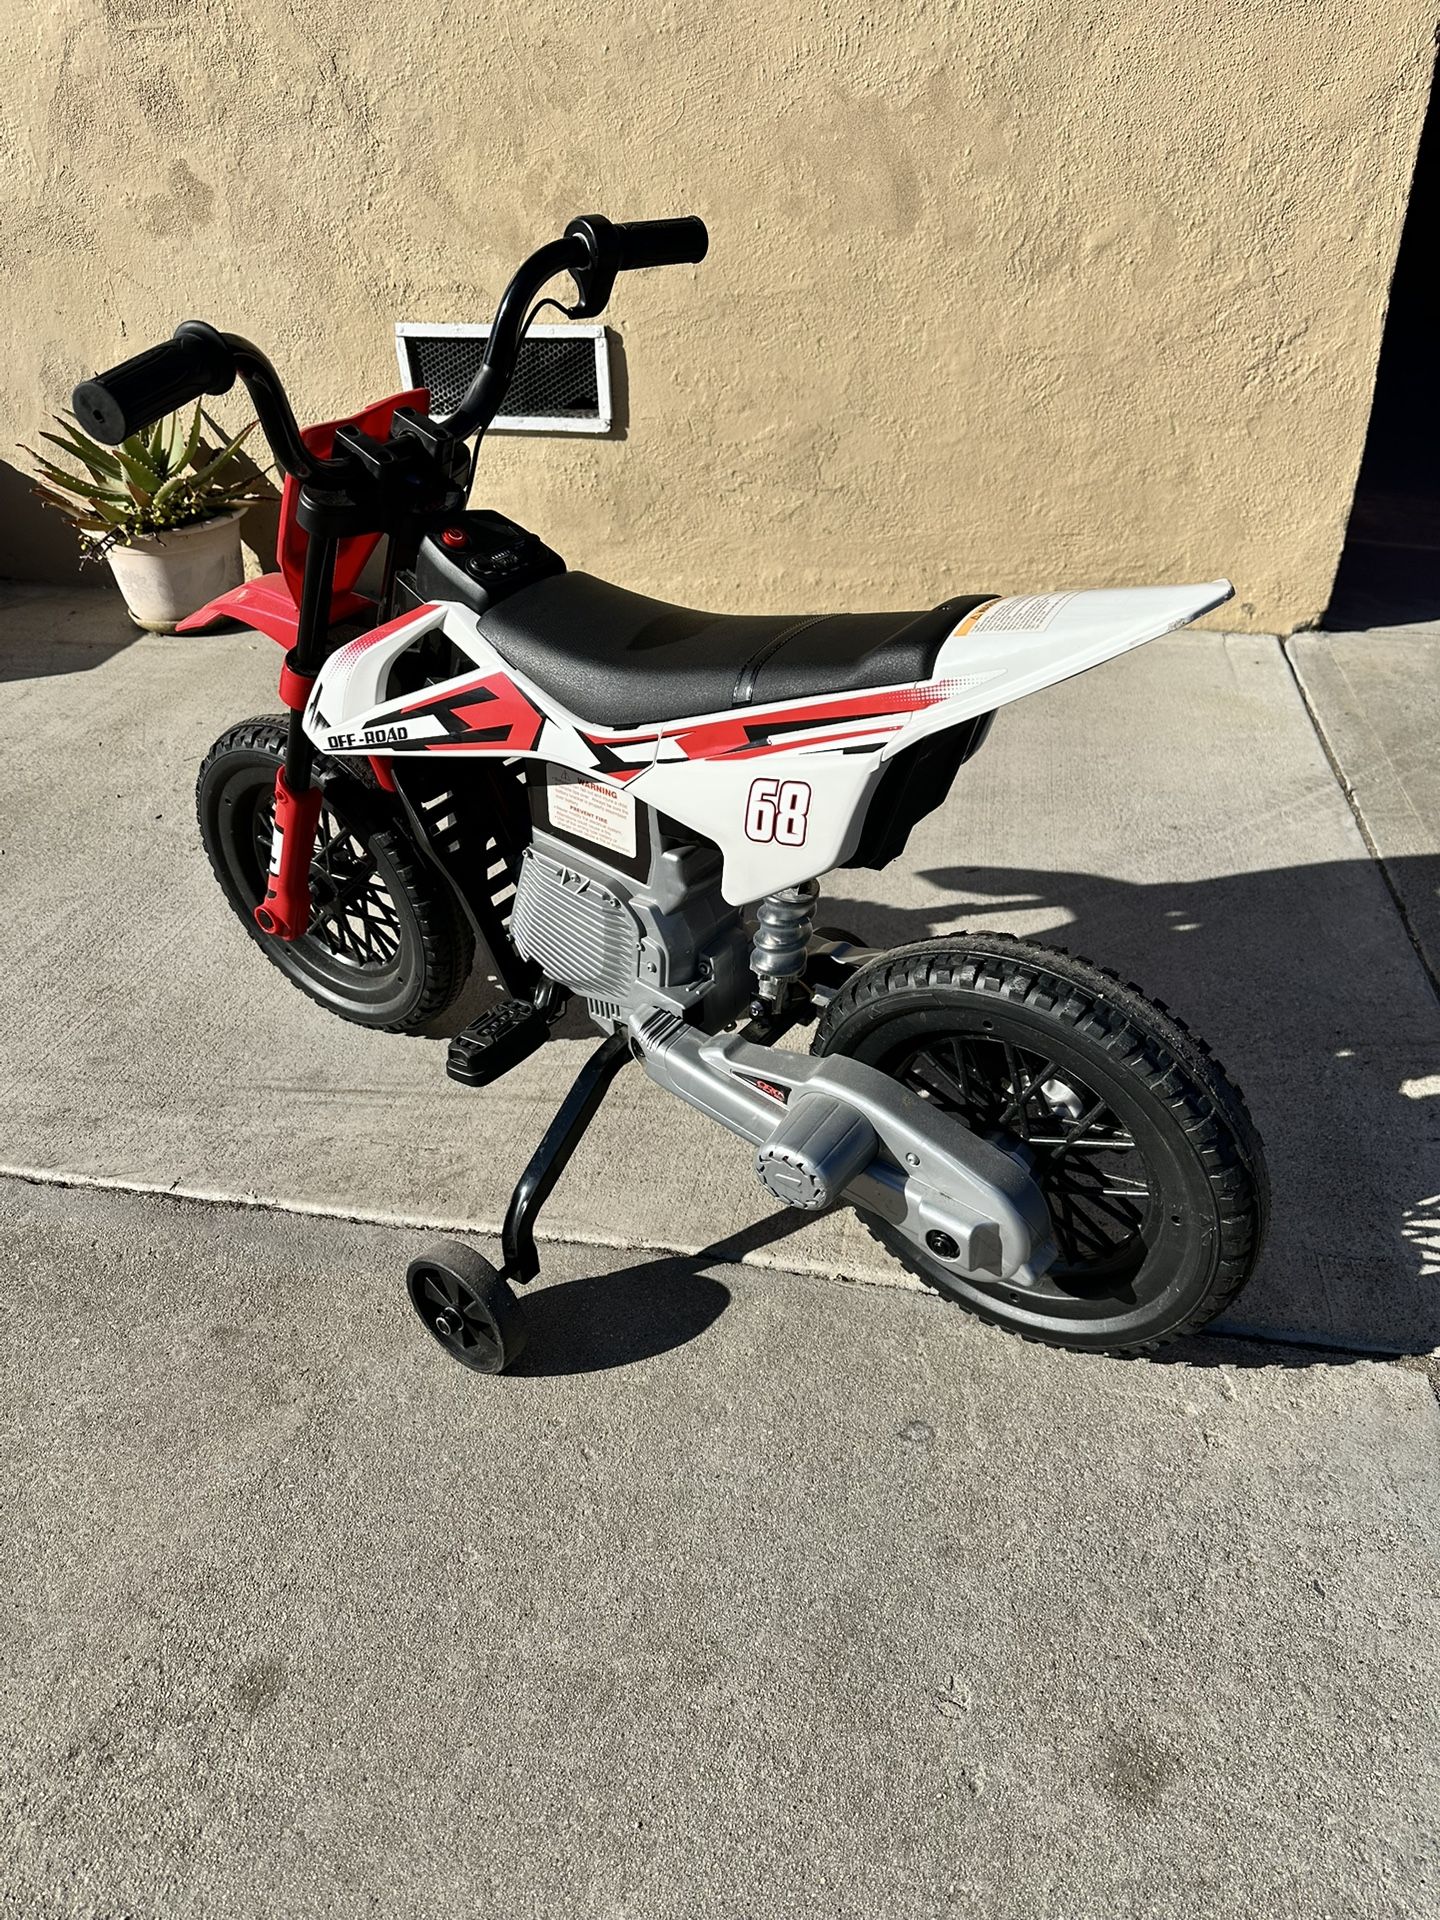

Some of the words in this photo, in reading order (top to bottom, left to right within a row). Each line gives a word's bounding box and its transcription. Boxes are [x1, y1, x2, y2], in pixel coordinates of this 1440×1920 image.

[578, 777, 618, 799] WARNING
[569, 805, 594, 818] PREVENT
[595, 815, 608, 824] FIRE
[744, 777, 811, 847] 68
